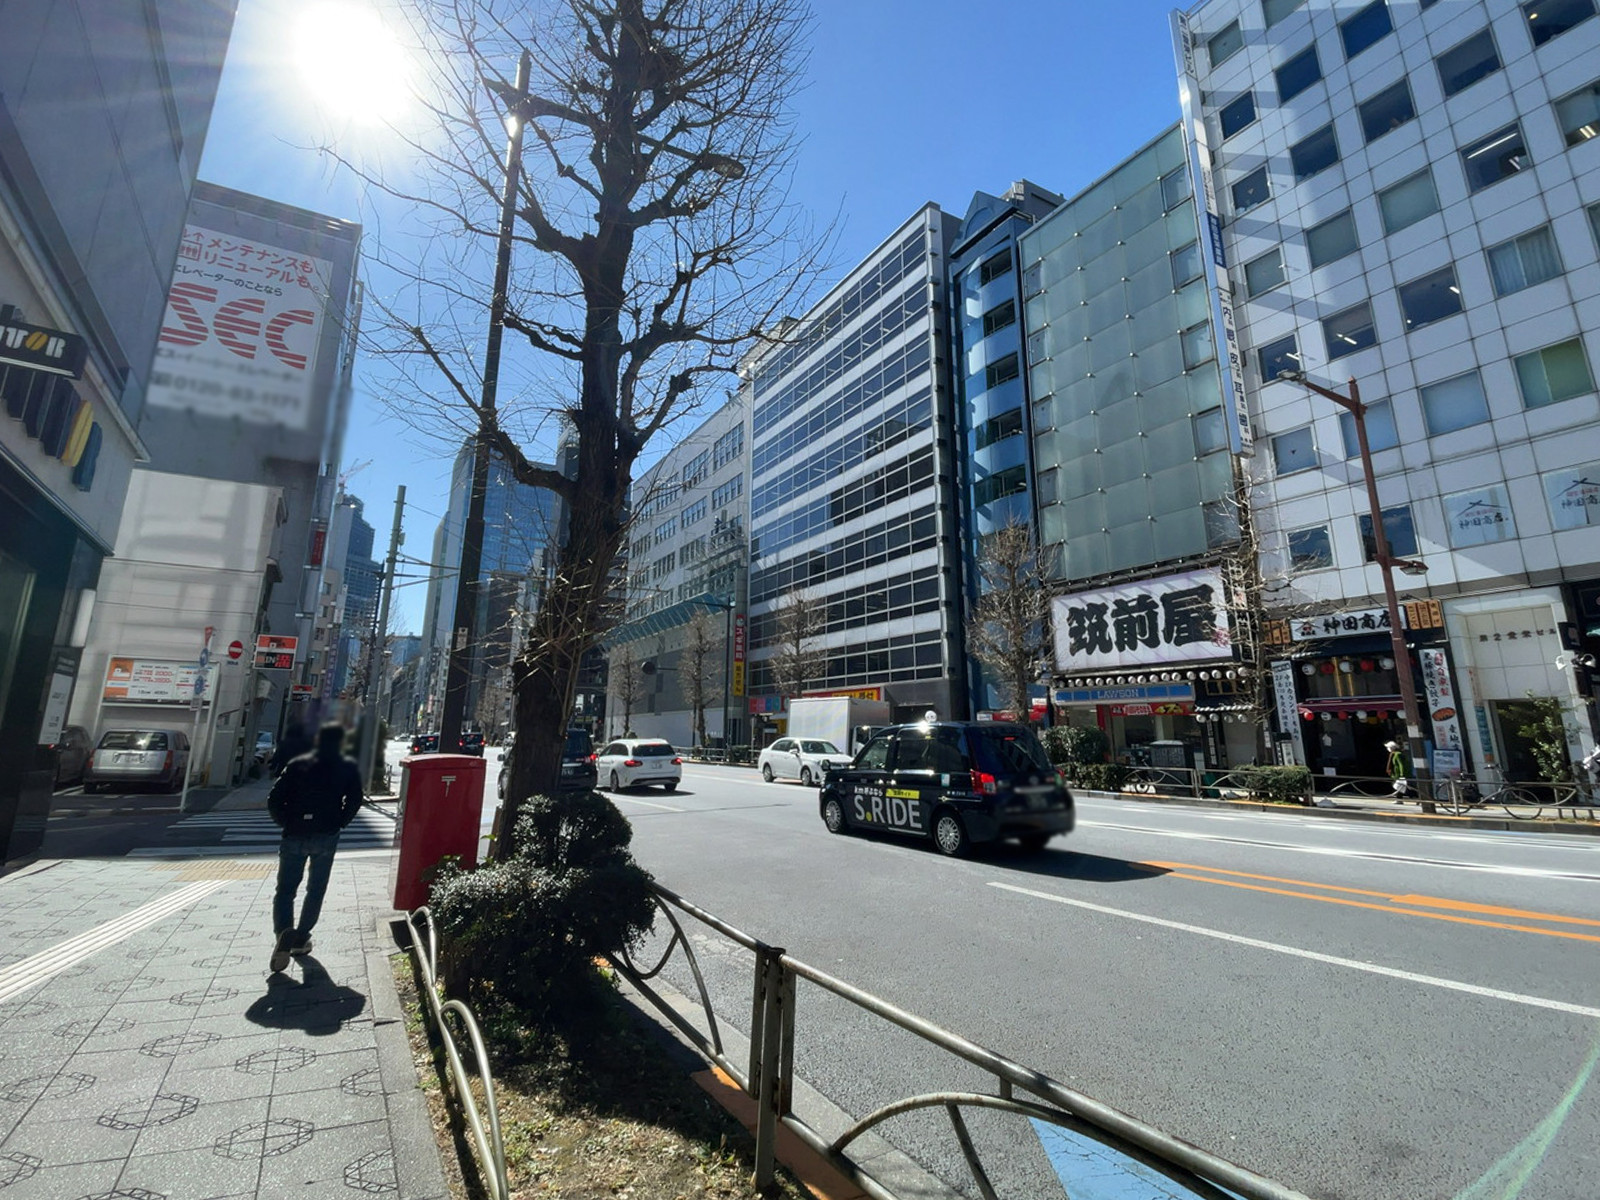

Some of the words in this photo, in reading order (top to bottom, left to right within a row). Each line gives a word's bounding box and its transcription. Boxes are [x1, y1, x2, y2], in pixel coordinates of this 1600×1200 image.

[207, 238, 314, 274] メンテナンスも
[173, 265, 283, 297] エレベーターのことなら
[159, 281, 316, 370] SEC
[1067, 583, 1218, 657] 筑前屋
[1097, 688, 1139, 699] LAWSON
[854, 794, 923, 829] S.RIDE
